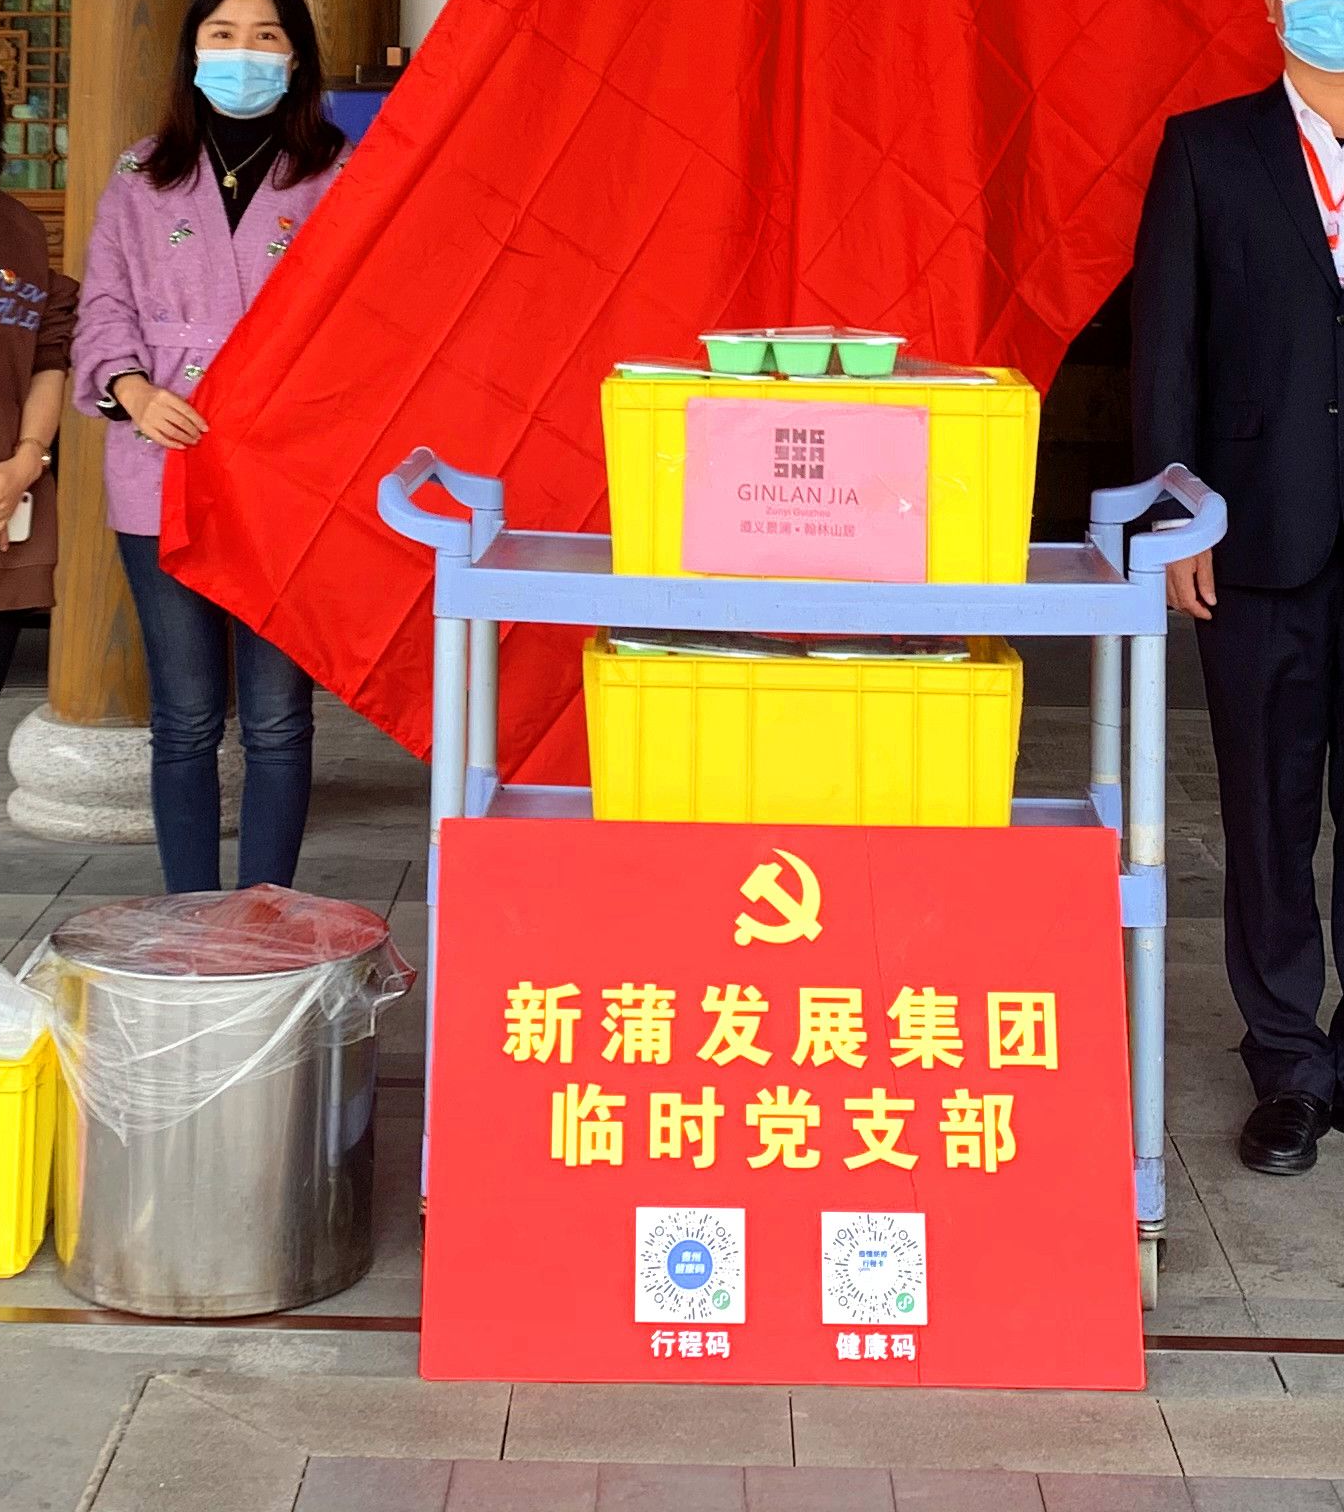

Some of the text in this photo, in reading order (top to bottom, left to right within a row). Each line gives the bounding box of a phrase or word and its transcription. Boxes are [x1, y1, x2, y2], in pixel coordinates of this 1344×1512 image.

[737, 483, 860, 505] GINLAN JIA
[502, 980, 1059, 1070] 新蒲发展集团
[550, 1084, 1018, 1173] 临时党支部
[650, 1330, 731, 1359] 行程码
[836, 1332, 917, 1361] 健康码
